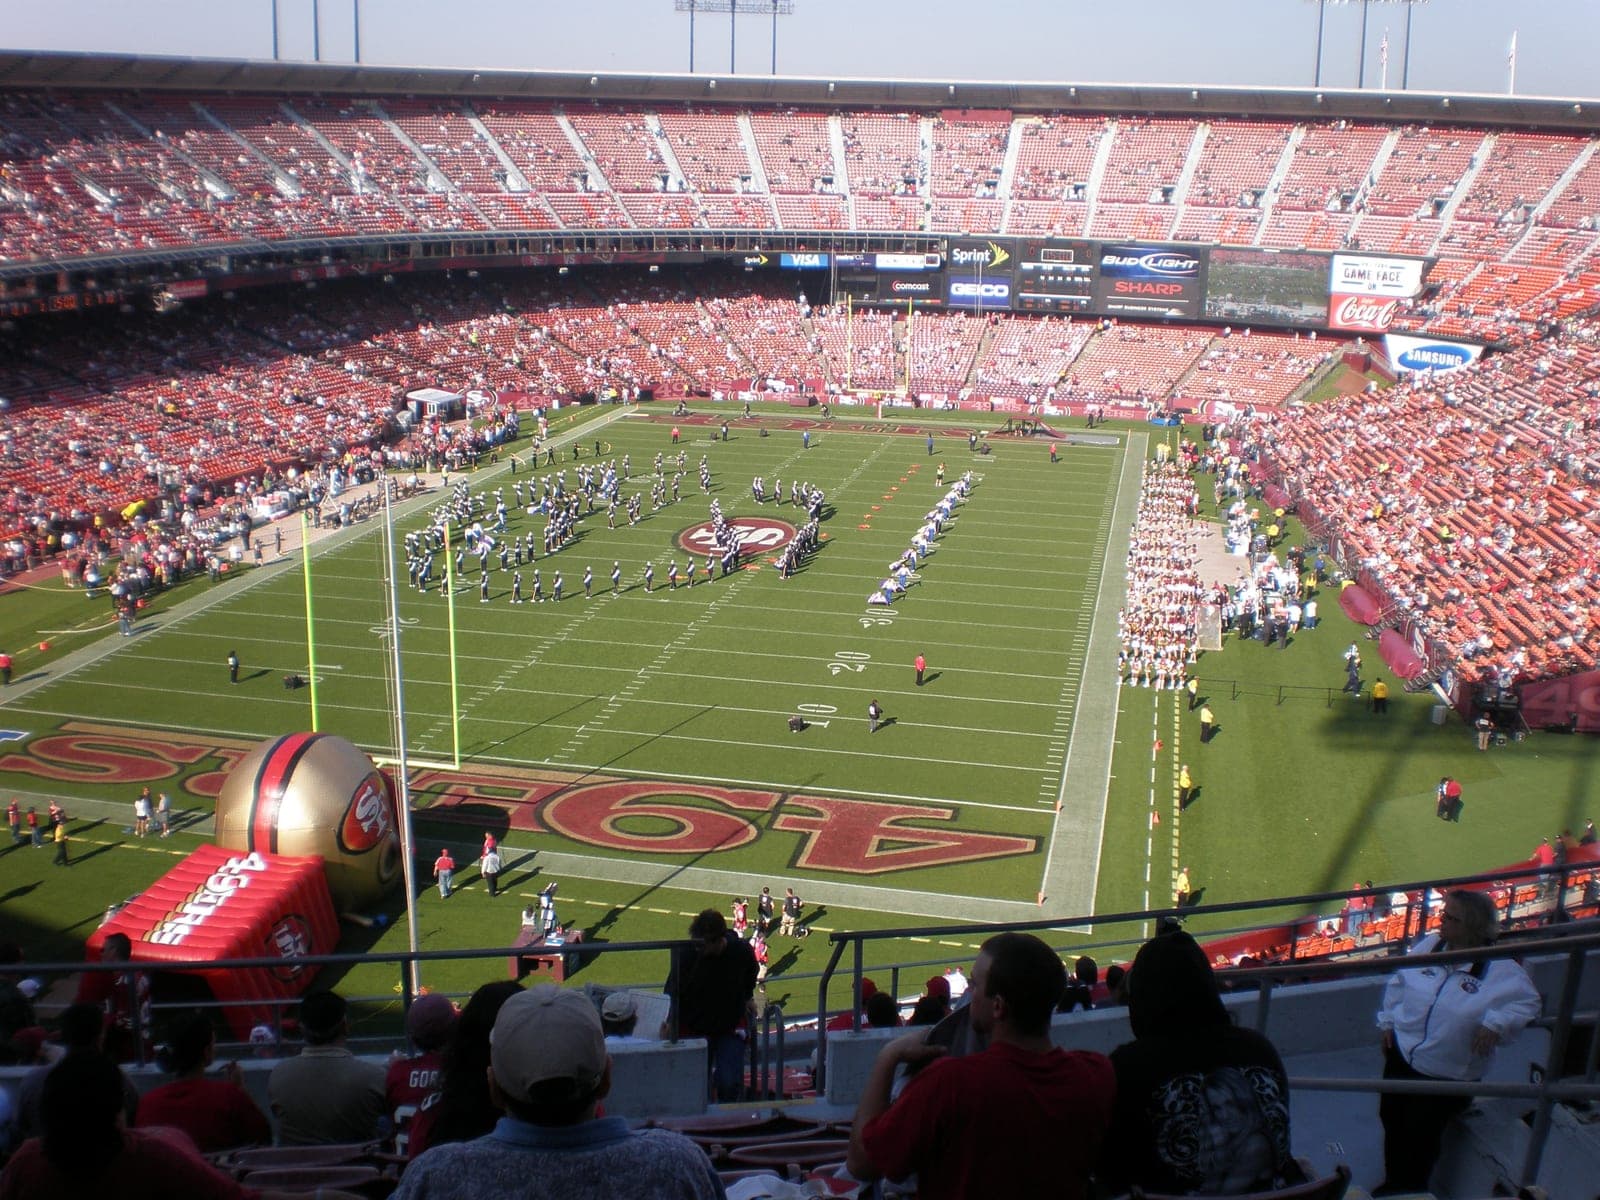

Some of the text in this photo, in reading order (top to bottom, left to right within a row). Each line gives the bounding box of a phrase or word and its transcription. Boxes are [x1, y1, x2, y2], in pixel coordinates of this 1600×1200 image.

[791, 253, 820, 266] VISA
[952, 248, 992, 264] Sprint
[1102, 255, 1199, 268] BUD LIGHT
[1343, 267, 1401, 282] GAME FACE
[893, 281, 930, 292] comcast
[951, 283, 1009, 298] GEICO
[1114, 281, 1184, 295] SHARP
[1406, 349, 1464, 366] SAMSUNG
